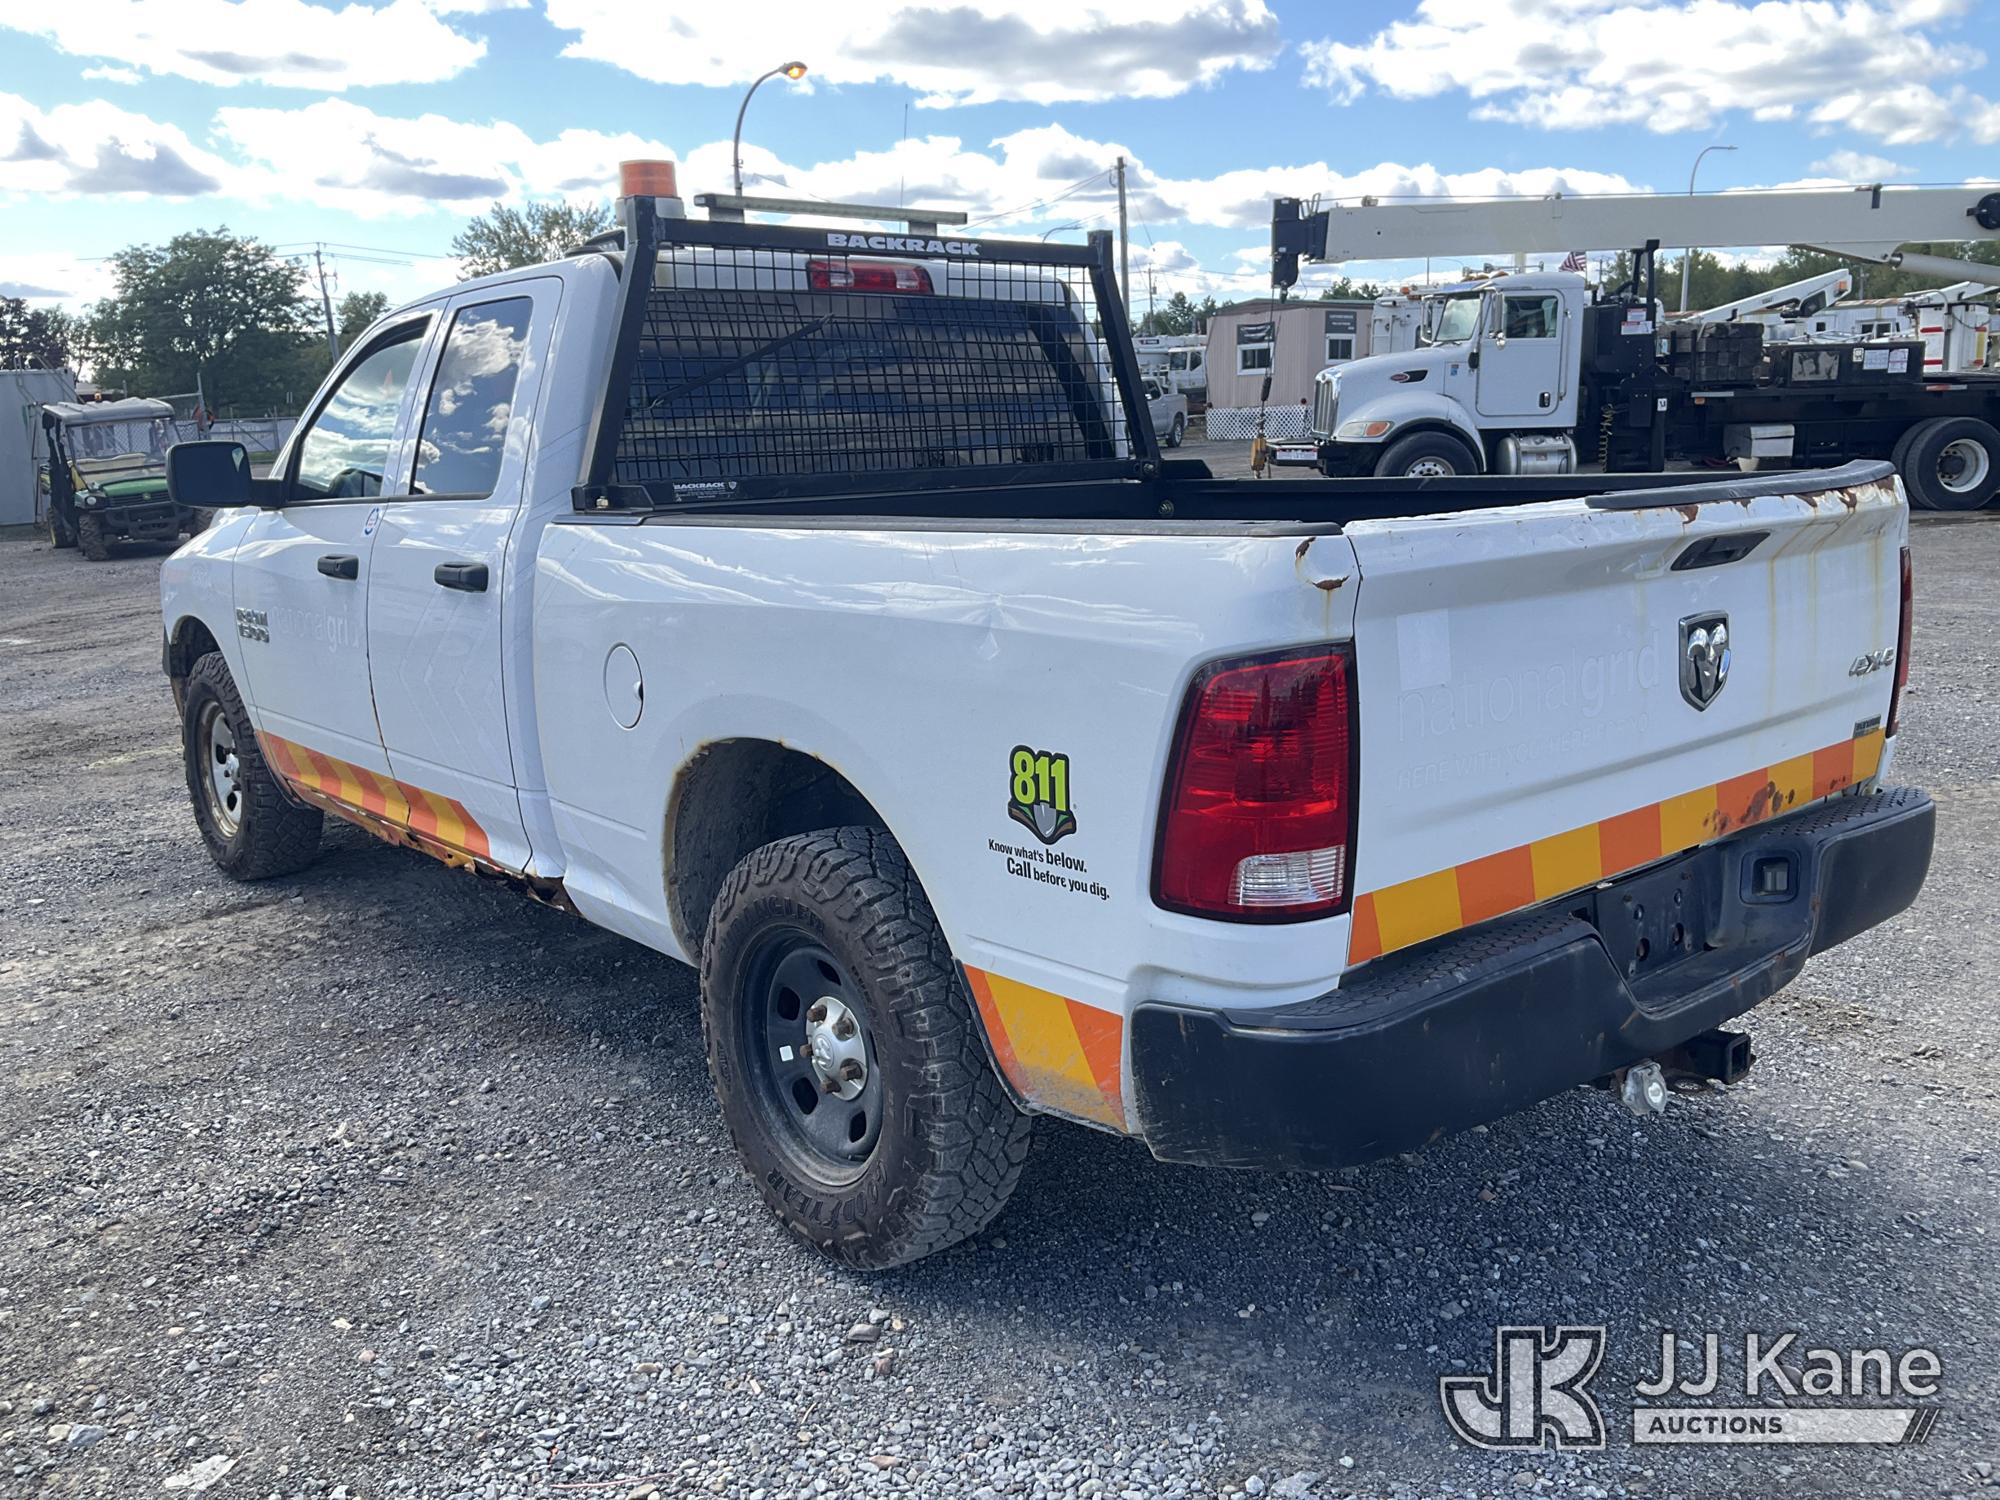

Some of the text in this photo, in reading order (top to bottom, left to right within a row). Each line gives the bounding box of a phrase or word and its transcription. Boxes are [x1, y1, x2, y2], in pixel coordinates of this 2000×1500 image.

[827, 233, 980, 256] BACKRACK
[673, 482, 725, 490] BACKRACK
[1012, 749, 1067, 812] 811
[988, 838, 1087, 873] Know what's below.
[1006, 857, 1110, 900] Call before you dig.
